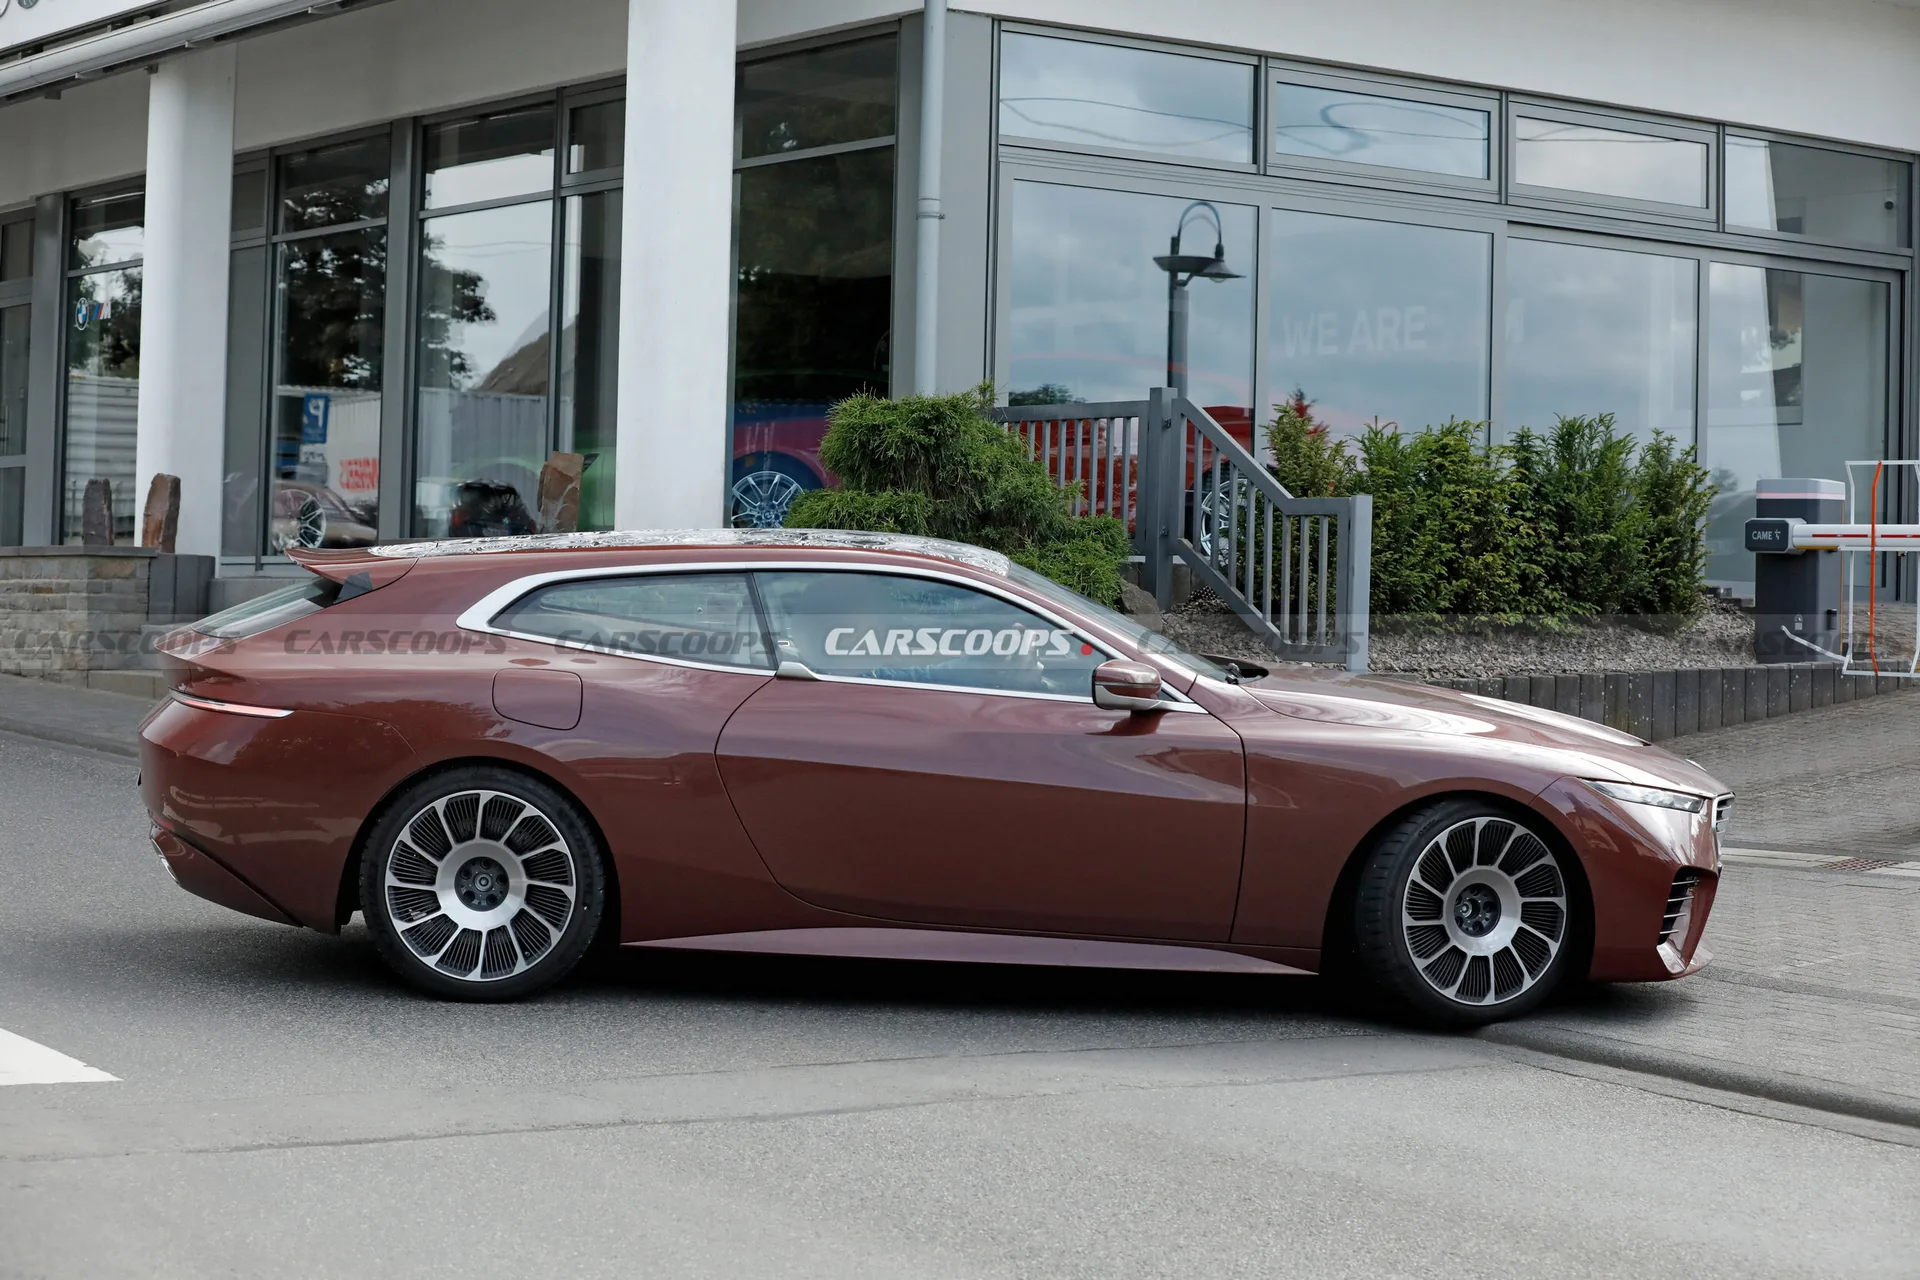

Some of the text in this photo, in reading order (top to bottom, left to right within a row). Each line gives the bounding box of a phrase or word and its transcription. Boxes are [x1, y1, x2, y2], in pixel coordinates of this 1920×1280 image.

[1283, 305, 1428, 358] WE ARE
[1752, 531, 1772, 539] CAME
